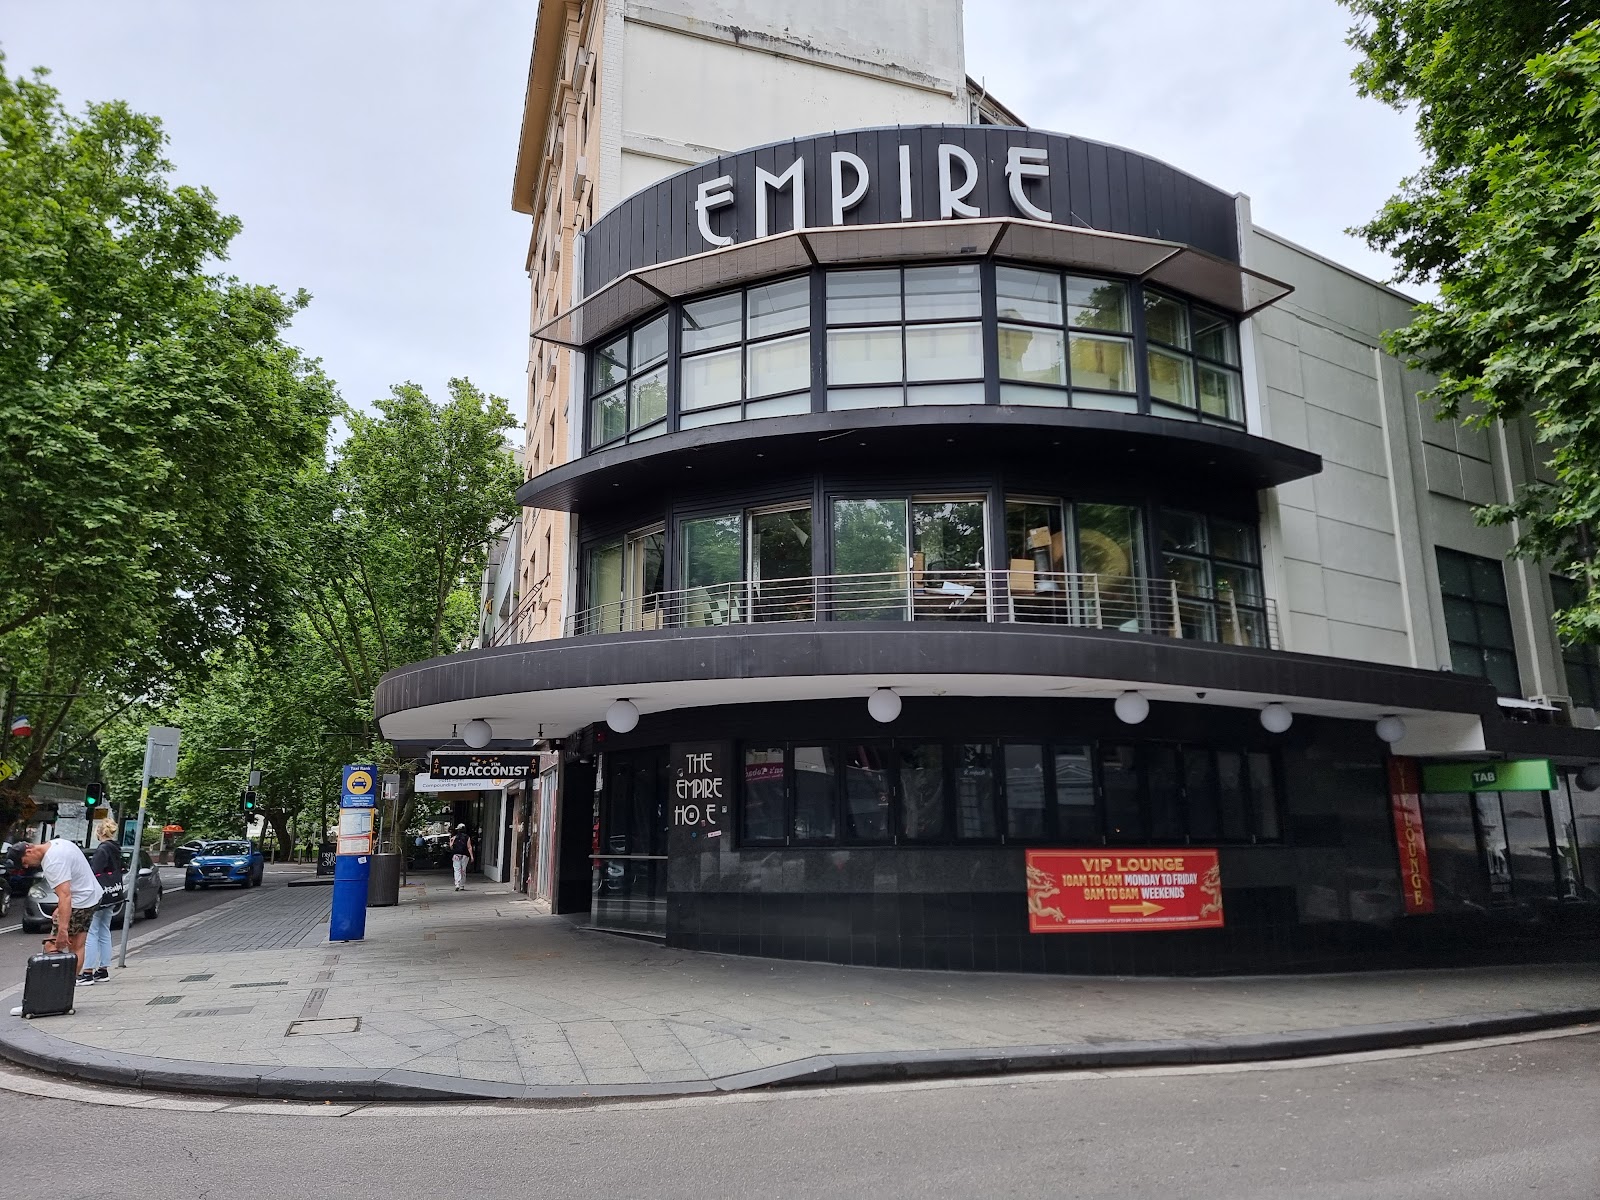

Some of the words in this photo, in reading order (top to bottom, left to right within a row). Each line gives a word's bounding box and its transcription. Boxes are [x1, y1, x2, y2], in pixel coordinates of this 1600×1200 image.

[694, 143, 1053, 247] EMPIRE
[685, 752, 713, 774] THE
[441, 766, 529, 776] TOBACCONIST
[1474, 772, 1495, 783] TAB
[422, 781, 457, 789] Compounding
[458, 780, 482, 788] Pharmacy
[676, 777, 722, 799] EMPIRE
[1081, 858, 1113, 872] VIP
[1116, 858, 1185, 872] LOUNGE
[1062, 874, 1088, 887] 10AM
[1089, 874, 1102, 887] TO
[1103, 873, 1123, 887] 4AM
[1123, 873, 1161, 886] MONDAY
[1161, 873, 1173, 886] TO
[1173, 872, 1198, 885] FRIDAY
[1105, 888, 1118, 900] TO
[1140, 886, 1185, 899] WEEKENDS
